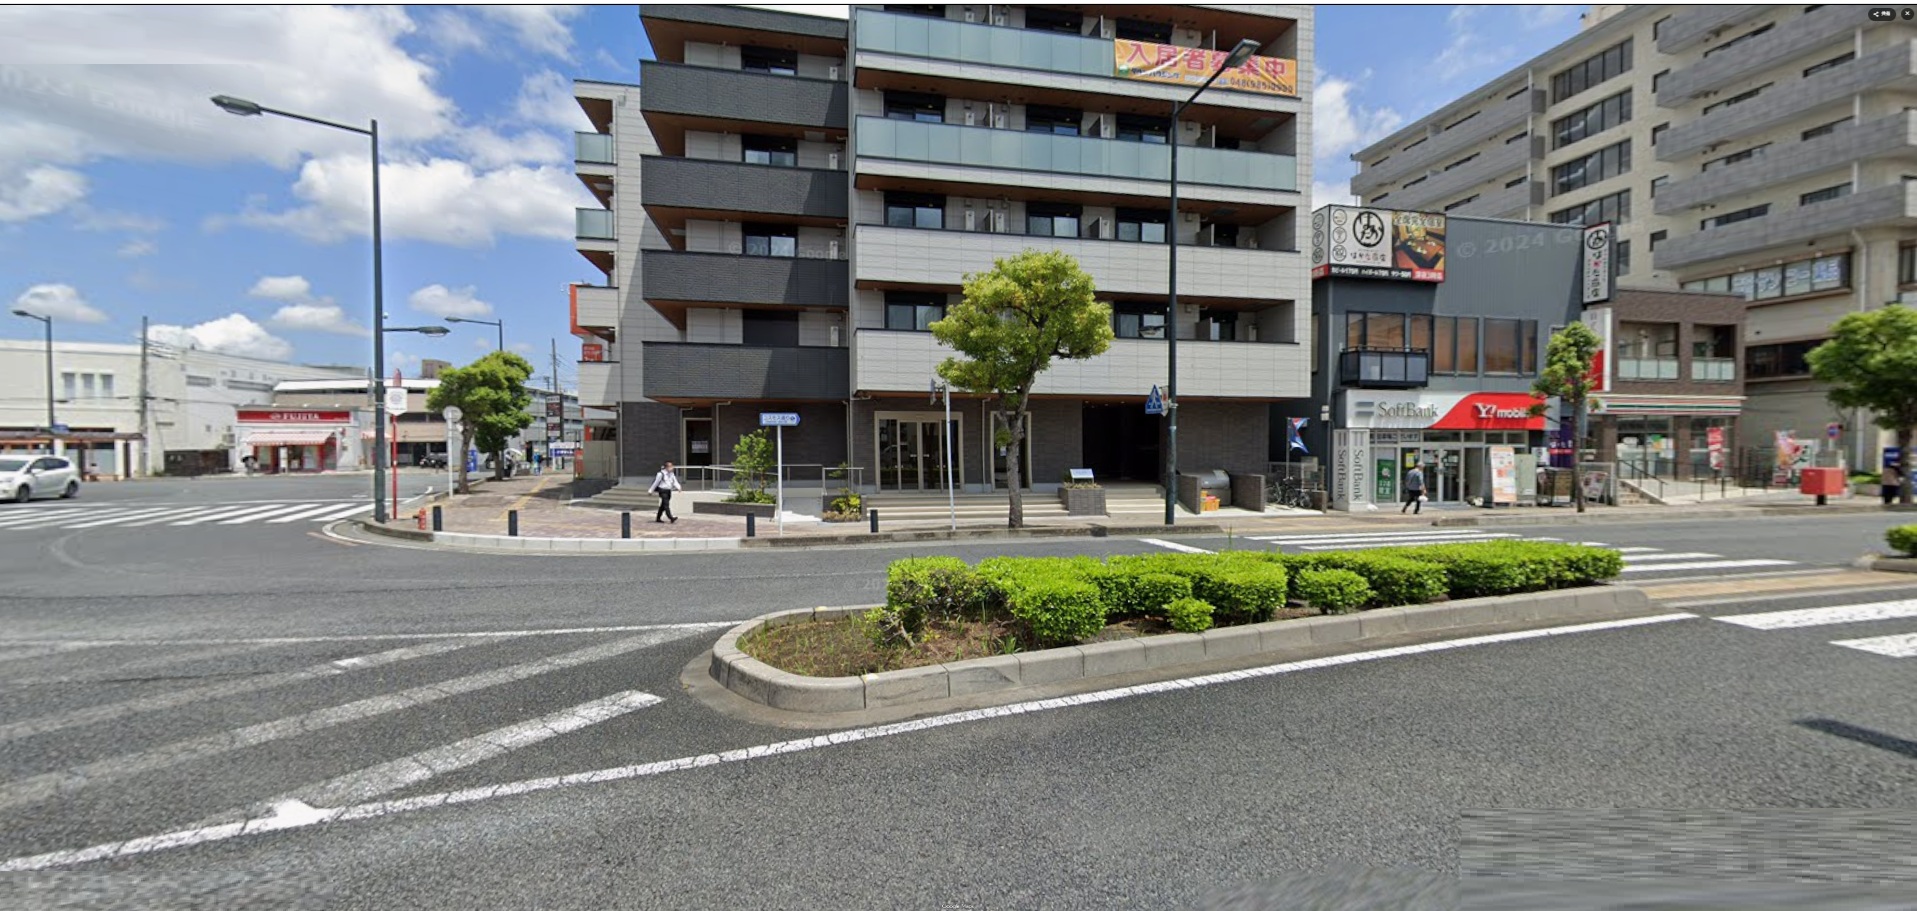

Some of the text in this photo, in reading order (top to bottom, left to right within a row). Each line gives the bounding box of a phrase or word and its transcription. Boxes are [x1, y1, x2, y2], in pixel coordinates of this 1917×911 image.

[1378, 401, 1439, 418] SoftBank
[1337, 449, 1347, 501] SoftBank
[1353, 449, 1364, 501] SoftBank
